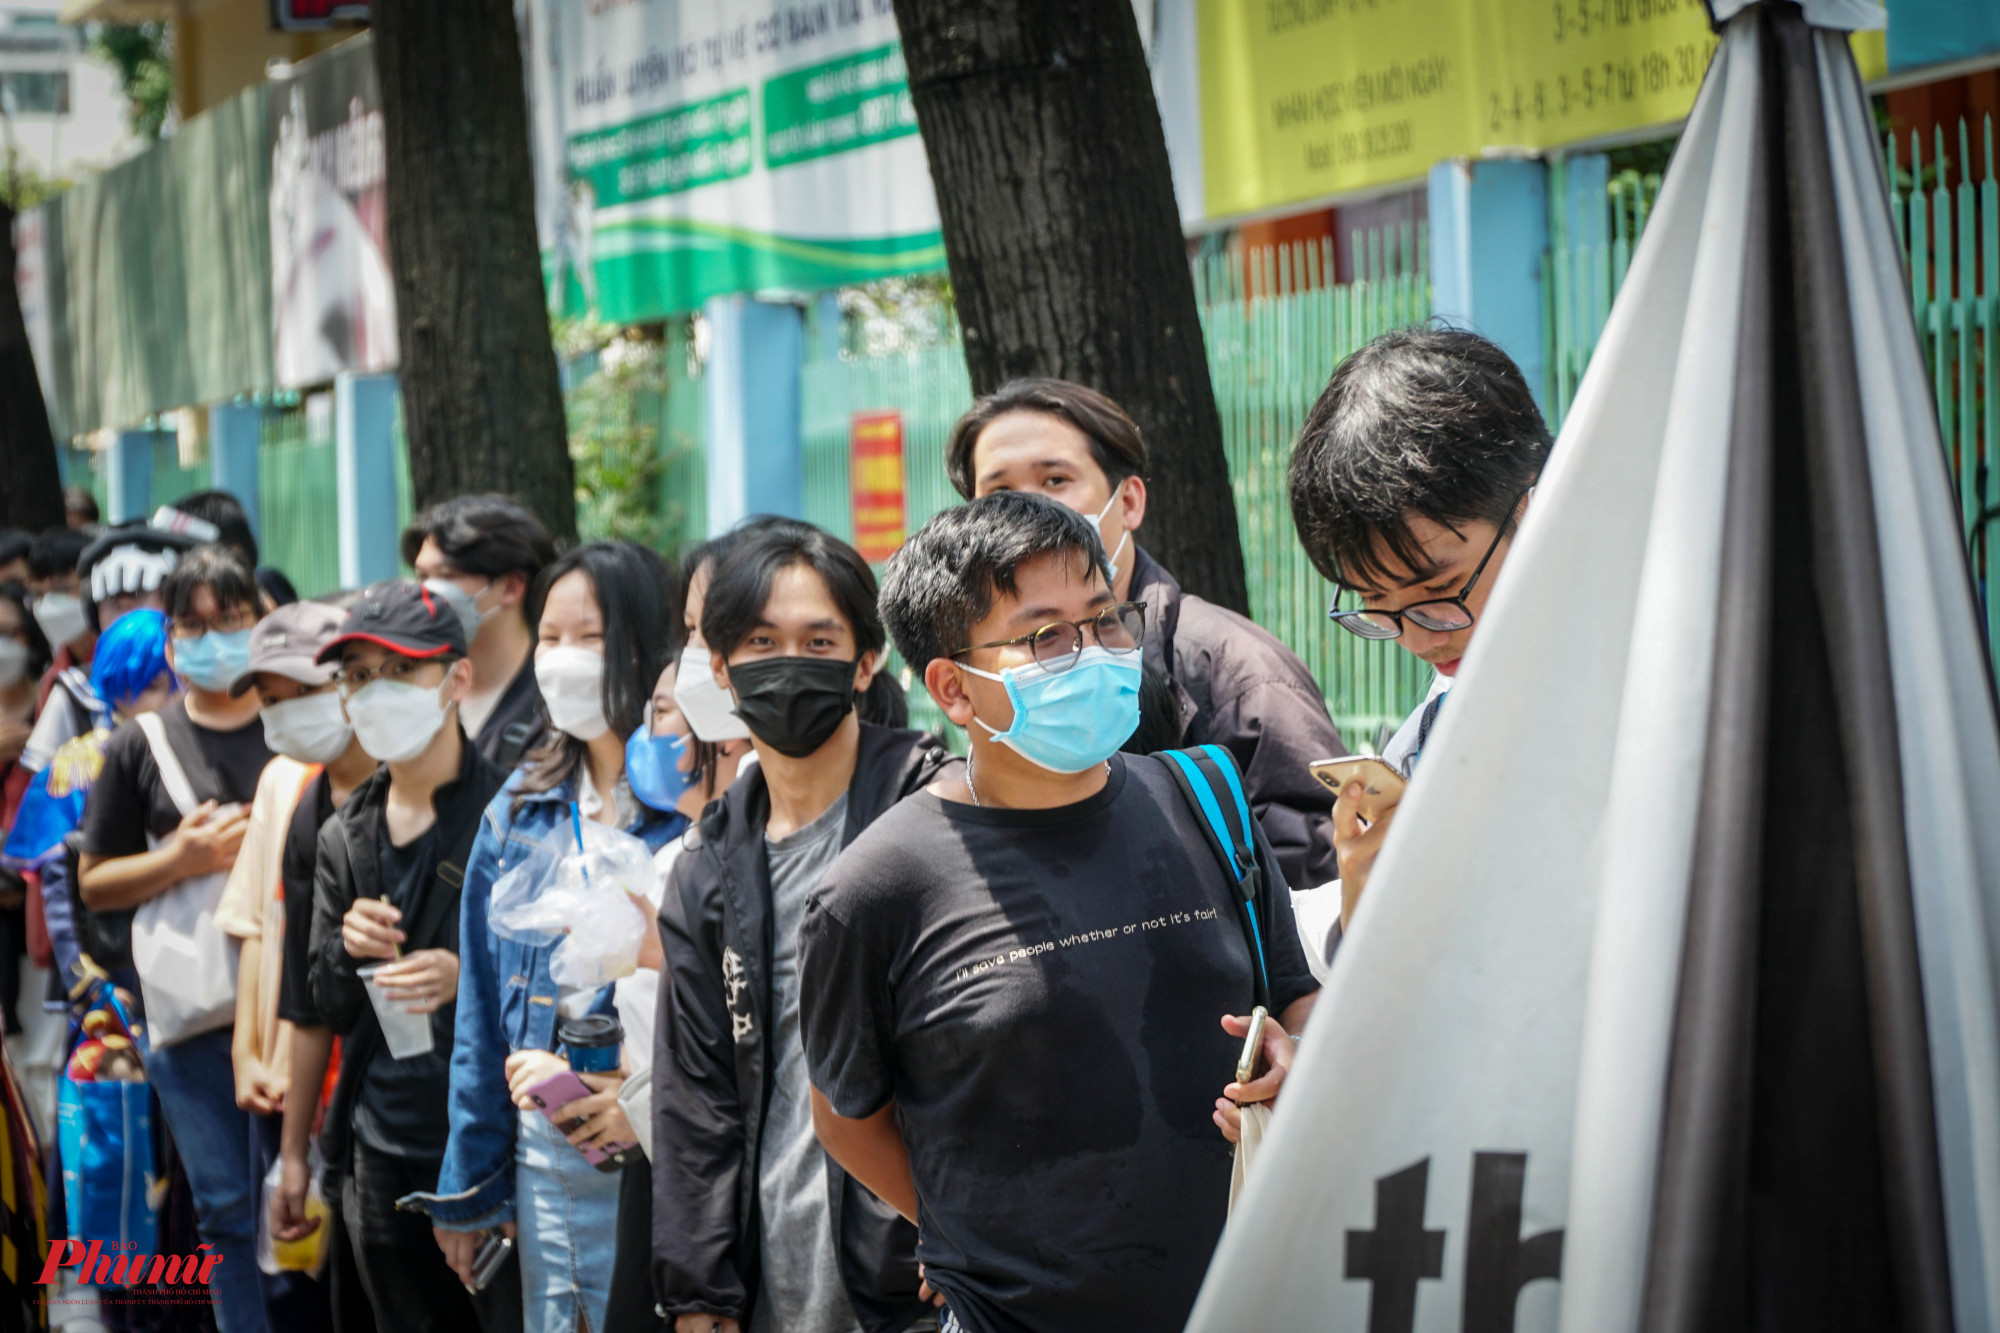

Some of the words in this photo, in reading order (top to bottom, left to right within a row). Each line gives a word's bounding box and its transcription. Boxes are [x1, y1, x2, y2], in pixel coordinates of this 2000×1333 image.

[973, 954, 1005, 975] save
[1009, 941, 1055, 964] people
[1059, 927, 1118, 948] whether
[1123, 923, 1137, 935] or
[1142, 916, 1167, 931] not
